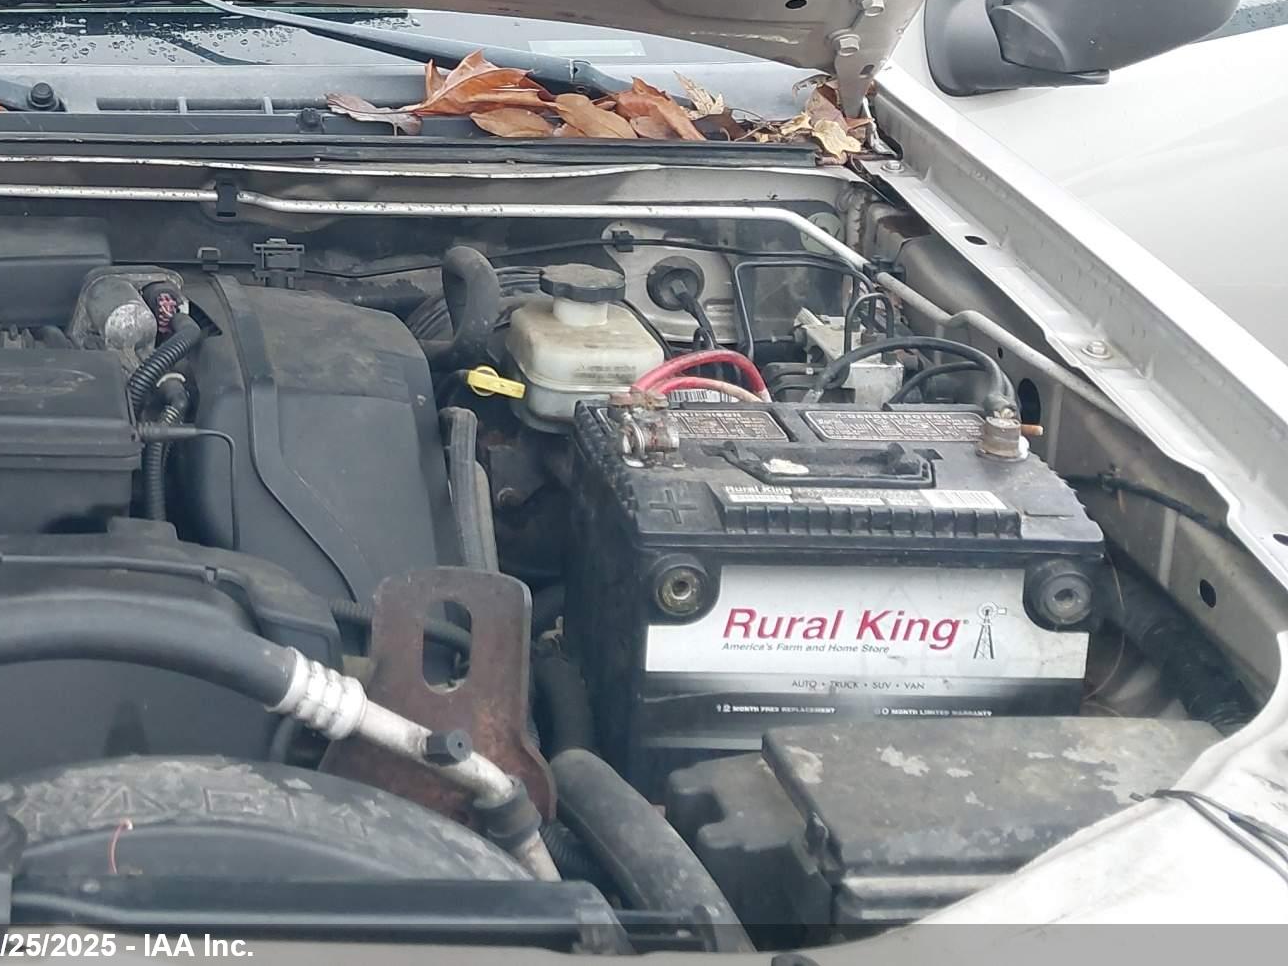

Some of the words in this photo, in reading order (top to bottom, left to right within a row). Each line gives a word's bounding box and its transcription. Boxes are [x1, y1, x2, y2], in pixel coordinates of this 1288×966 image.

[722, 608, 844, 640] Rural
[856, 609, 962, 651] King
[722, 642, 773, 652] America's
[776, 643, 803, 652] Farm
[805, 644, 826, 652] and
[828, 644, 858, 653] Home
[862, 644, 890, 654] Store
[792, 679, 817, 689] AUTO
[830, 680, 859, 690] TRUCK
[872, 681, 892, 690] SUV
[904, 681, 926, 690] VAN
[732, 705, 759, 713] MONTH
